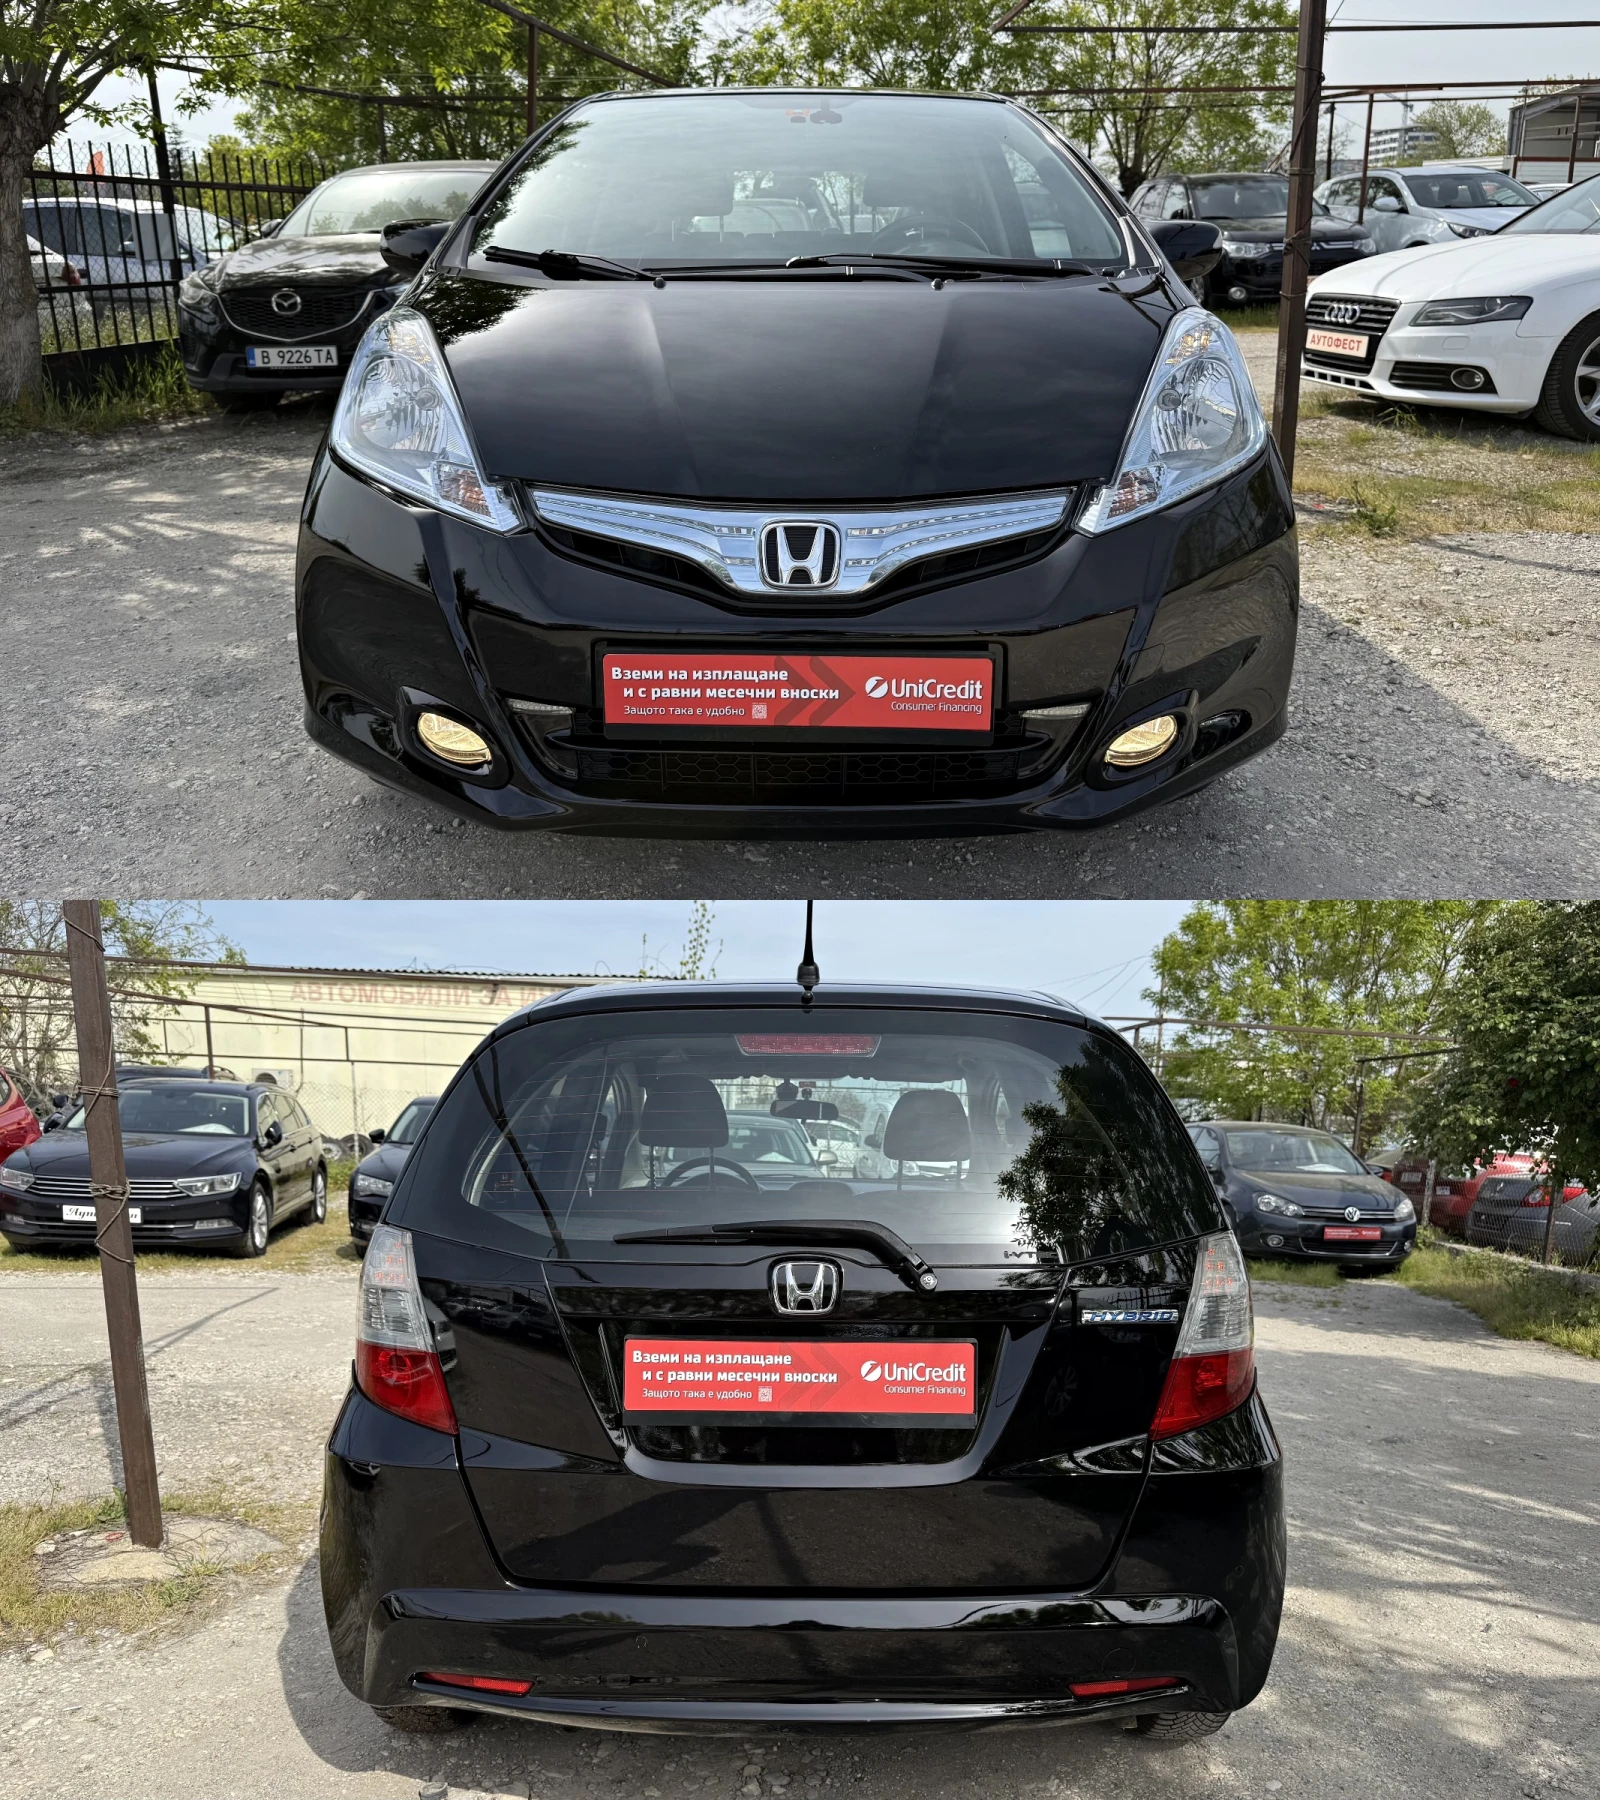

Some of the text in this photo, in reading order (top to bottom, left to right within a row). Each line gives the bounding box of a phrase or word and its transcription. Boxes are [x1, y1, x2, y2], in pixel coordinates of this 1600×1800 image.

[1309, 333, 1362, 352] АУТОФЕСТ
[611, 666, 789, 683] Вземи на изплащане
[623, 687, 840, 700] и с равни месечни вноски
[891, 678, 983, 700] UniCredit
[623, 705, 746, 718] Защото така е удобно
[890, 701, 982, 715] Consumer Financing
[290, 983, 470, 1006] АВТОМОБИЛИ
[478, 986, 512, 1007] ЗА
[1090, 1311, 1174, 1322] HYBRID
[632, 1350, 792, 1367] Вземи на изплащане
[642, 1370, 838, 1384] и с равни месечни вноски
[884, 1362, 967, 1382] UniCredit
[642, 1388, 753, 1400] Защото така е удобно
[884, 1384, 966, 1397] Consumer Financing
